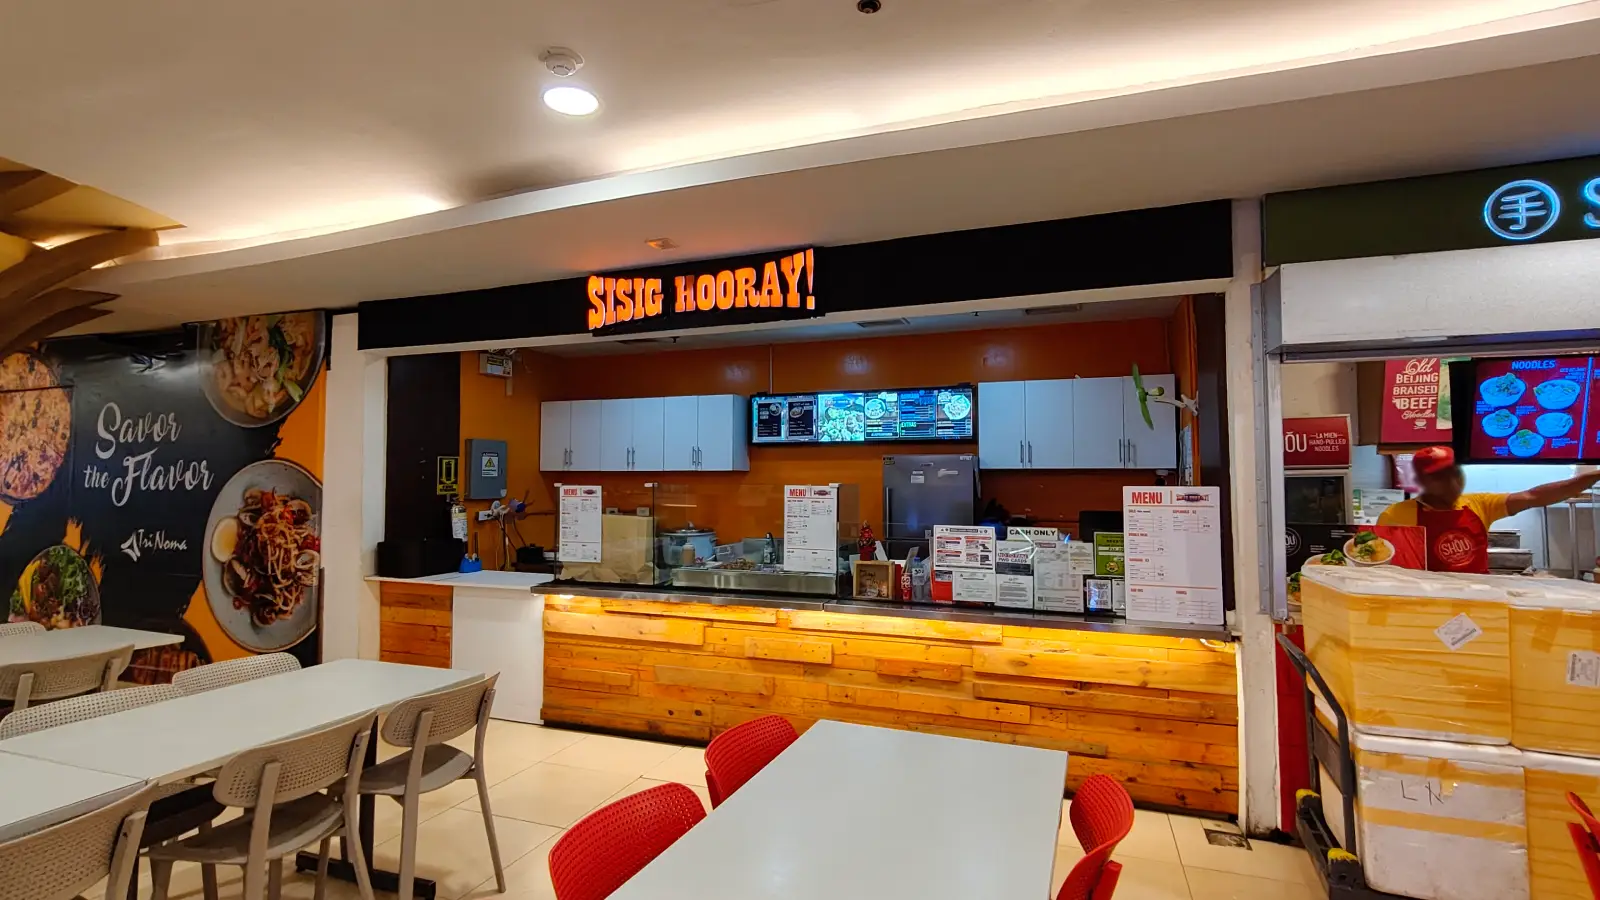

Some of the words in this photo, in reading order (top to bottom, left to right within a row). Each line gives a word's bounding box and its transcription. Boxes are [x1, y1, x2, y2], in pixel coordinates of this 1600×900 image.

[1497, 190, 1548, 230] 手
[588, 275, 664, 330] SISIG
[675, 248, 816, 313] HOORAY!
[1402, 358, 1437, 375] Old
[1511, 360, 1556, 370] NOODLES
[1396, 372, 1439, 384] BEIJING
[1393, 386, 1437, 395] BRAISED
[1399, 397, 1437, 410] BEEF
[95, 402, 182, 460] Savor
[83, 464, 109, 489] the
[111, 447, 215, 507] Flavor
[563, 488, 578, 496] MENU
[789, 488, 807, 497] MENU
[1131, 491, 1163, 504] MENU
